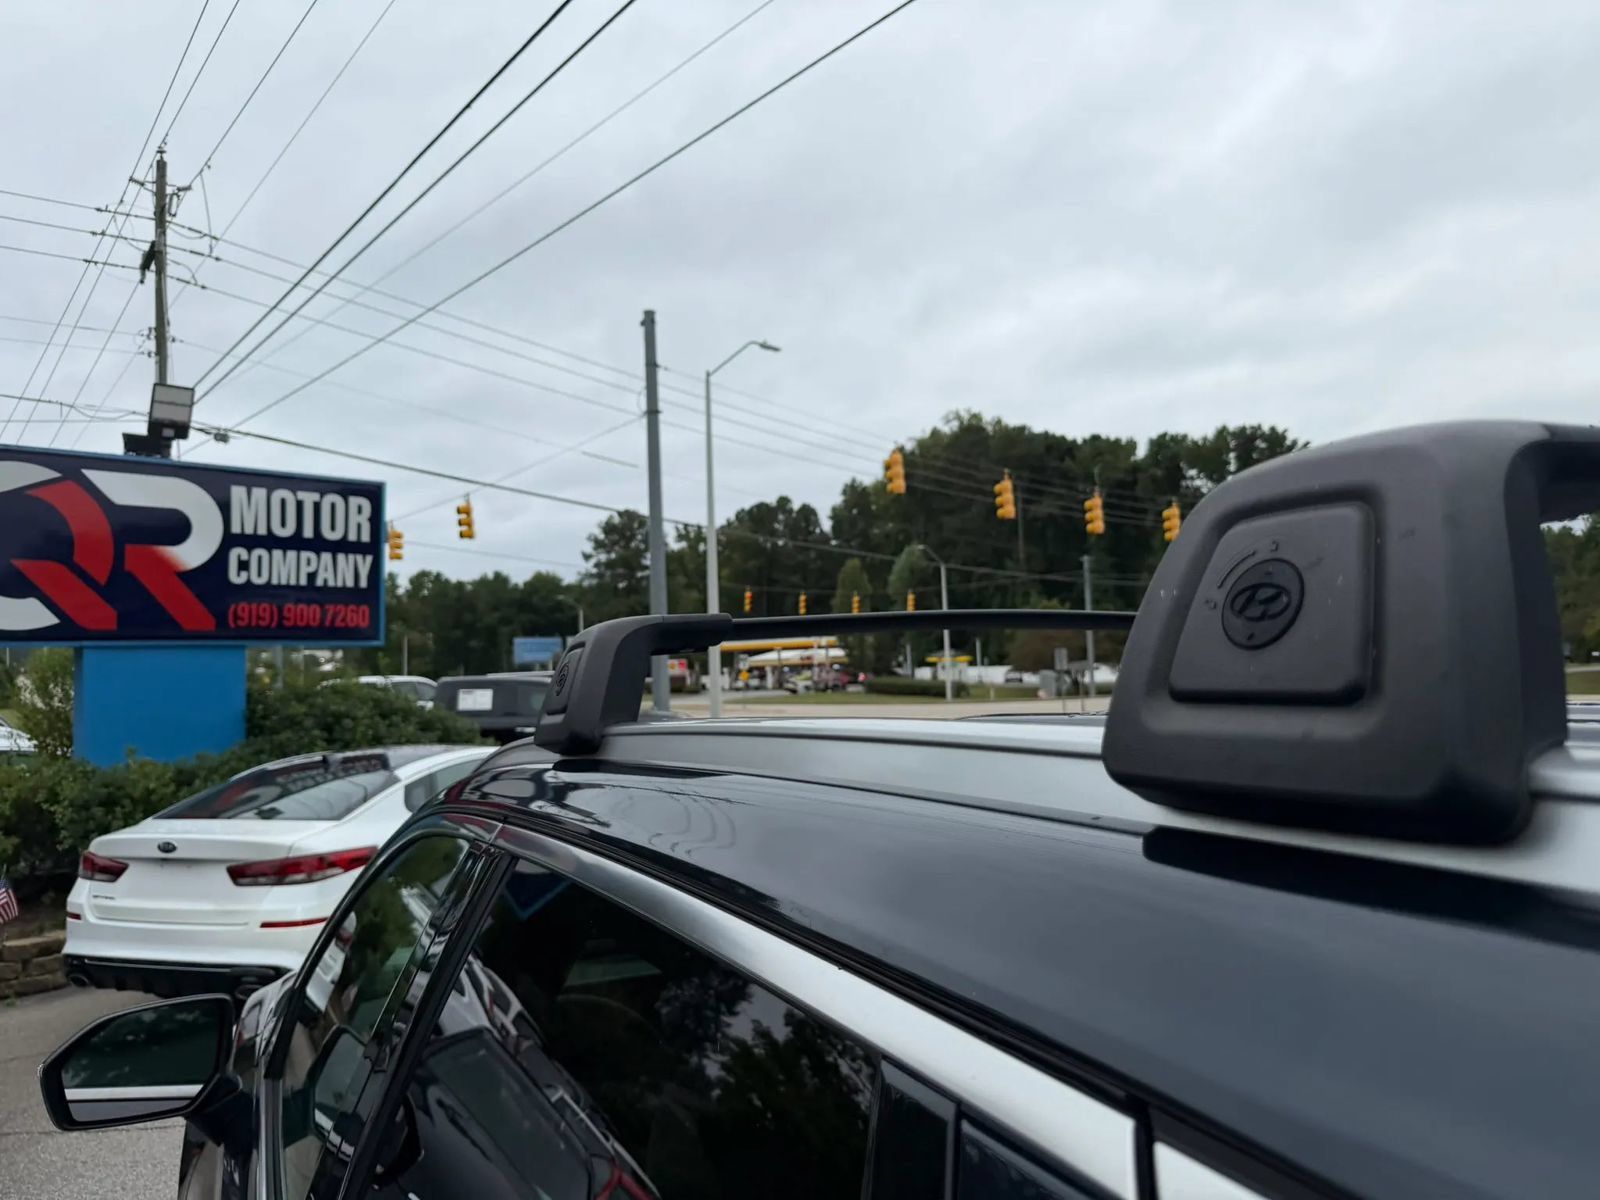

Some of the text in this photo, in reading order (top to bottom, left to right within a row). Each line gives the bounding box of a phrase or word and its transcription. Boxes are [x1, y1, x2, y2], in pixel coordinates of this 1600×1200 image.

[230, 484, 372, 543] MOTOR
[227, 546, 374, 589] COMPANY
[228, 602, 370, 628] (919) 900 7260
